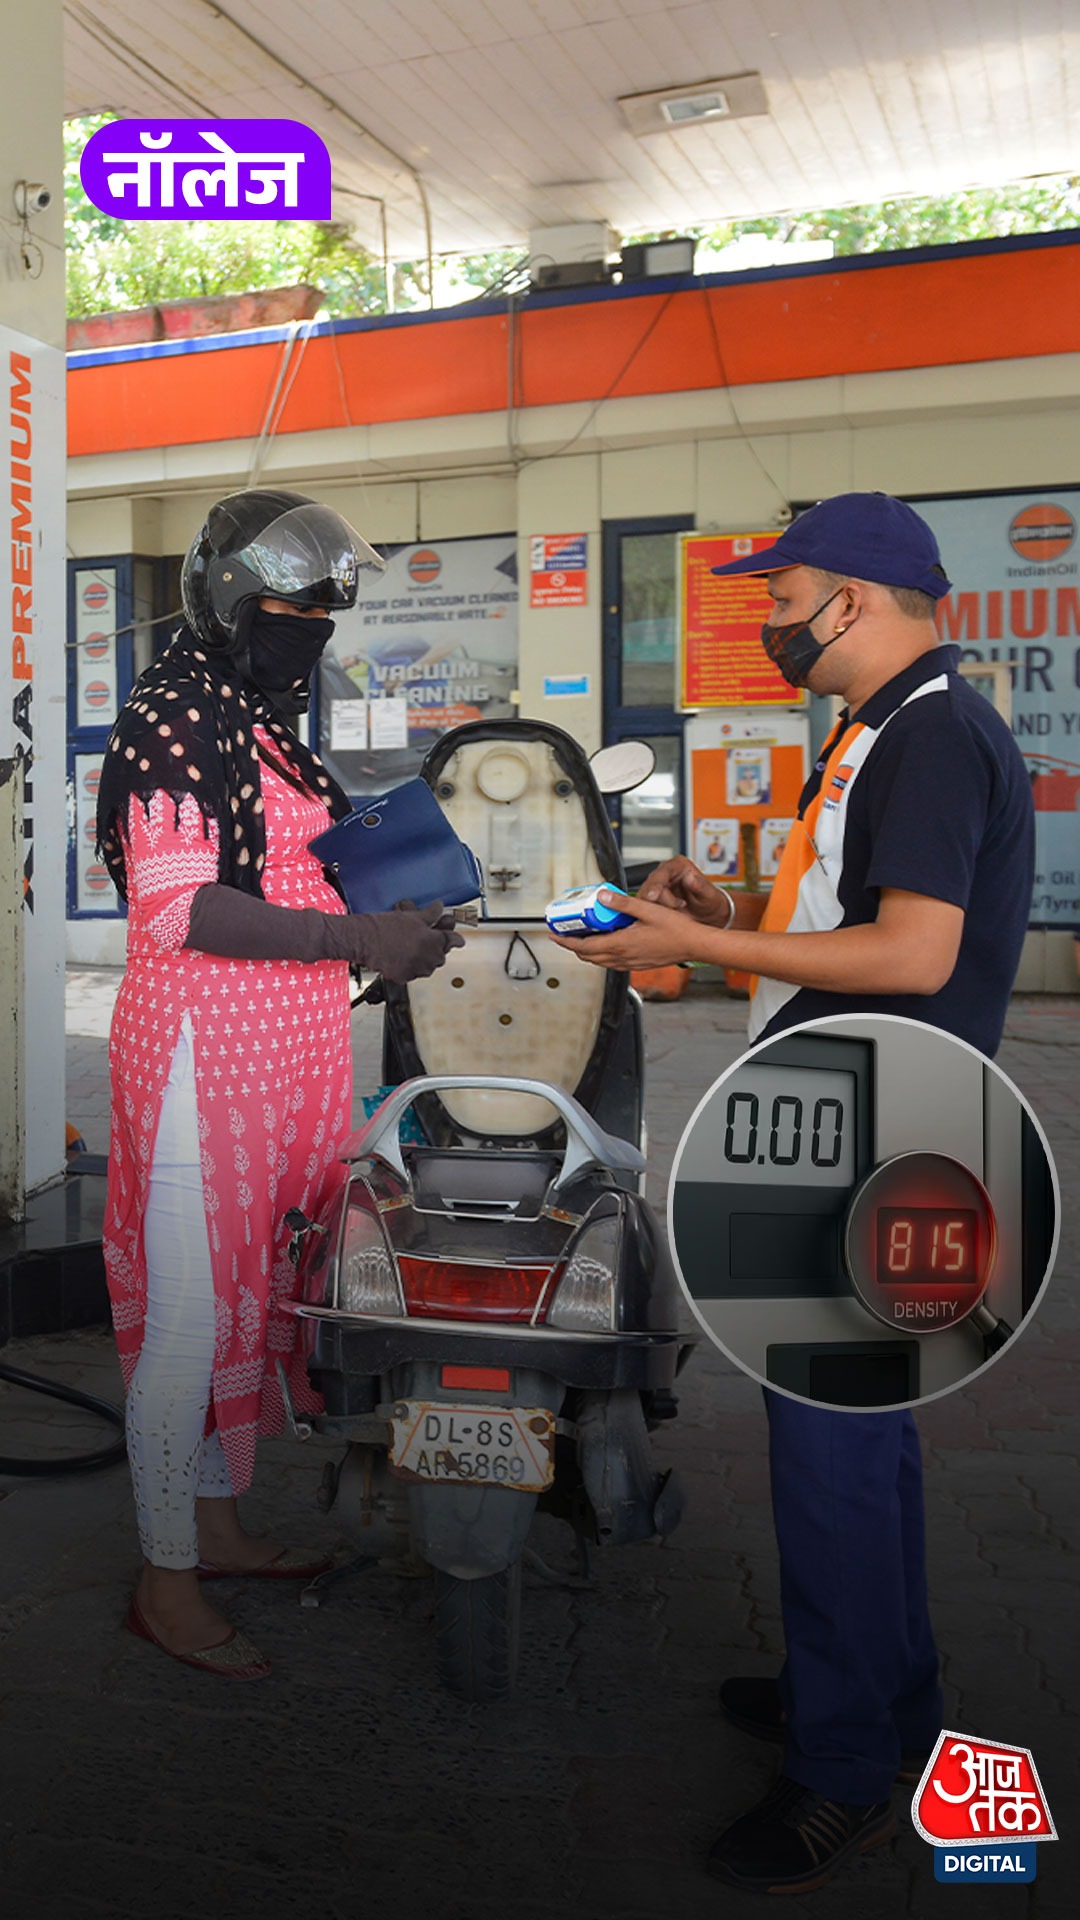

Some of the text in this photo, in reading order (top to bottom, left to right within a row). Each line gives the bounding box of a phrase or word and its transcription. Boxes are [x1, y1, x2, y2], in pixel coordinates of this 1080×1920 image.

[1008, 563, 1077, 577] IndianOil
[374, 661, 480, 682] VACUUM
[724, 1092, 844, 1168] 0.00
[888, 1221, 964, 1271] 815
[894, 1301, 959, 1319] DENSITY
